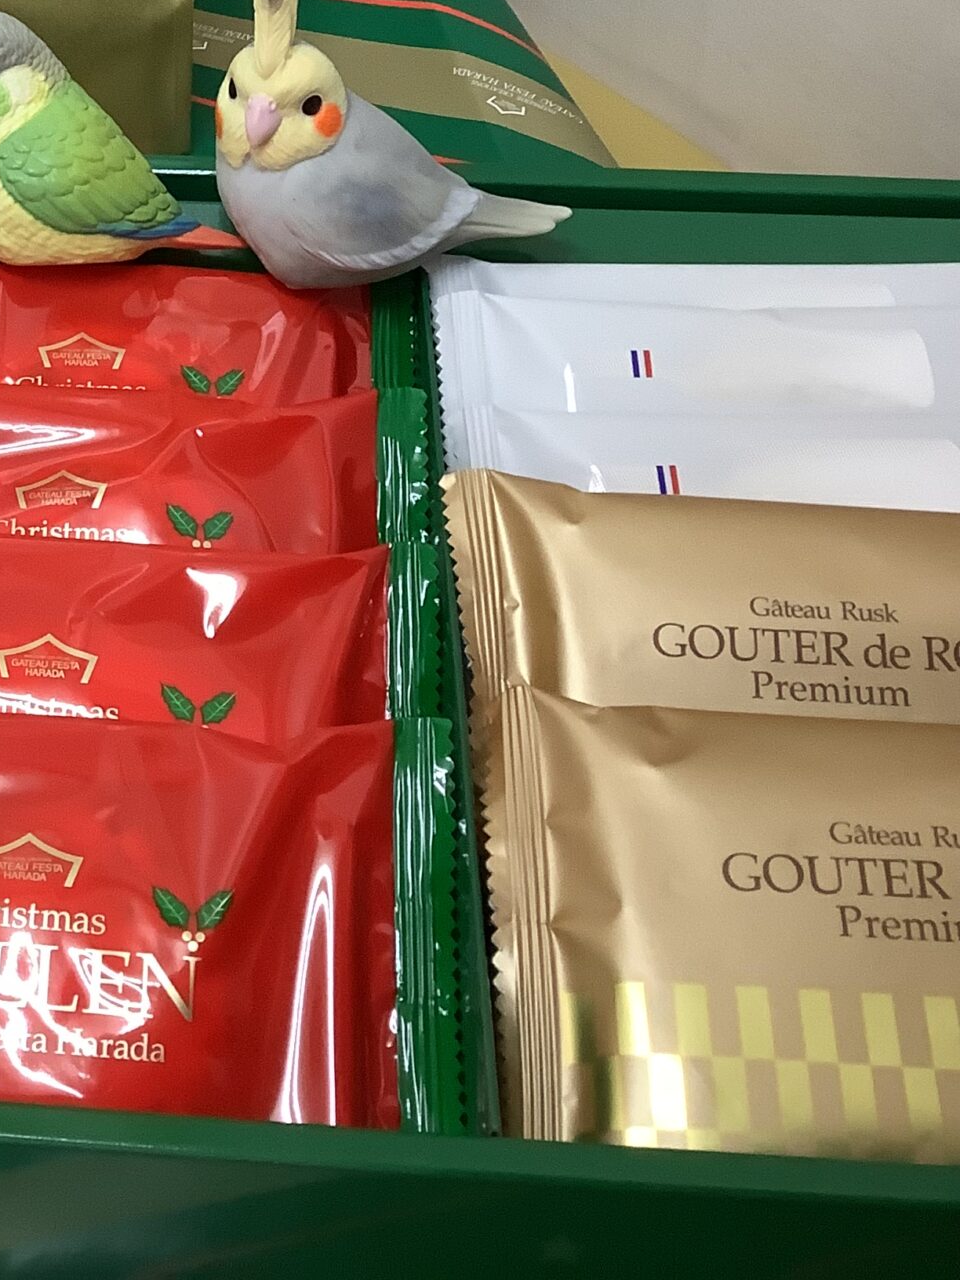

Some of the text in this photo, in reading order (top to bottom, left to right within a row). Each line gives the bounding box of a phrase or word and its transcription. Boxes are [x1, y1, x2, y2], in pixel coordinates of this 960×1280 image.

[452, 66, 500, 86] HARADA
[503, 82, 537, 100] FESTA
[52, 351, 112, 361] GATEAU FESTA
[64, 359, 99, 367] HARADA
[748, 596, 900, 623] Gâteau Rusk
[652, 622, 960, 673] GOUTER de R
[11, 658, 81, 671] GATEAU FESTA
[24, 668, 66, 679] HARADA
[750, 670, 913, 707] Premium
[829, 820, 922, 847] Gâteau
[3, 871, 47, 882] HARADA
[32, 862, 64, 873] FESTA
[722, 852, 953, 901] GOUTER
[835, 904, 960, 944] Premi
